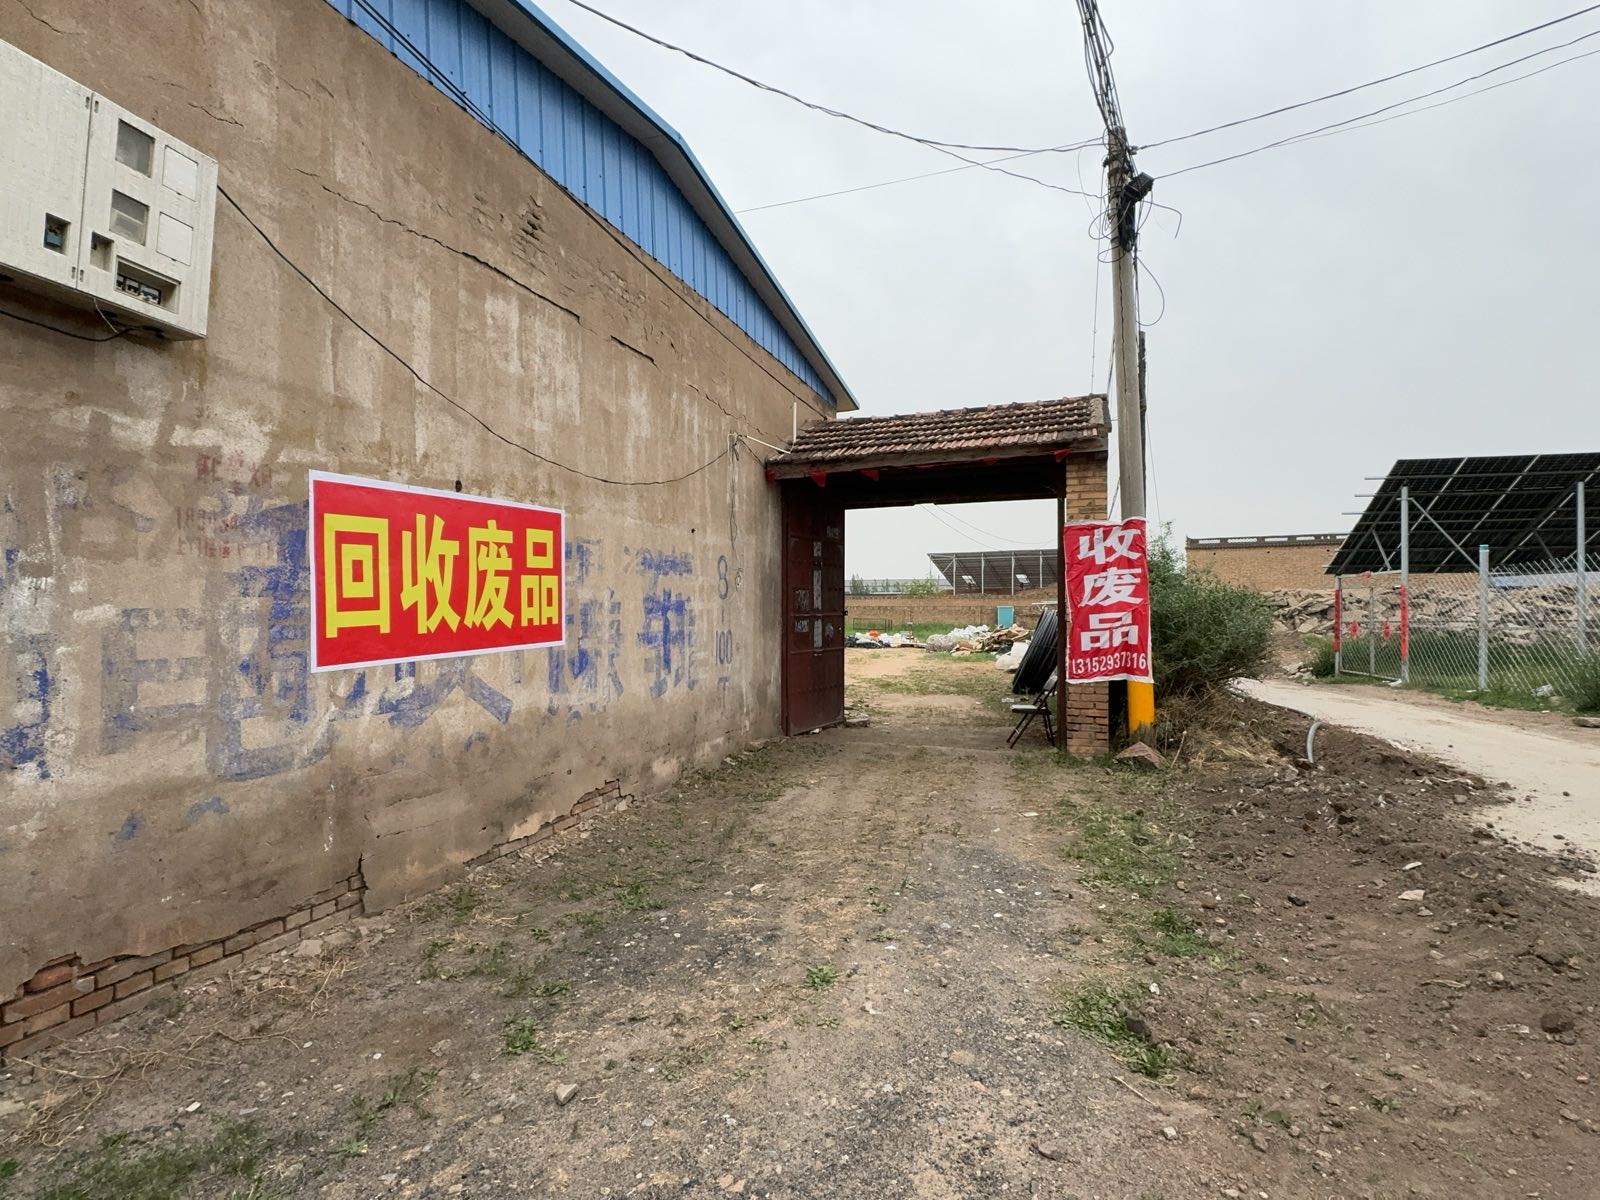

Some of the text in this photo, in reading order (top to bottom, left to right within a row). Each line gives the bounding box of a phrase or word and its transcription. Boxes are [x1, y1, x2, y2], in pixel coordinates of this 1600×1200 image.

[324, 513, 559, 638] 回收废品
[1077, 526, 1144, 651] 收废品
